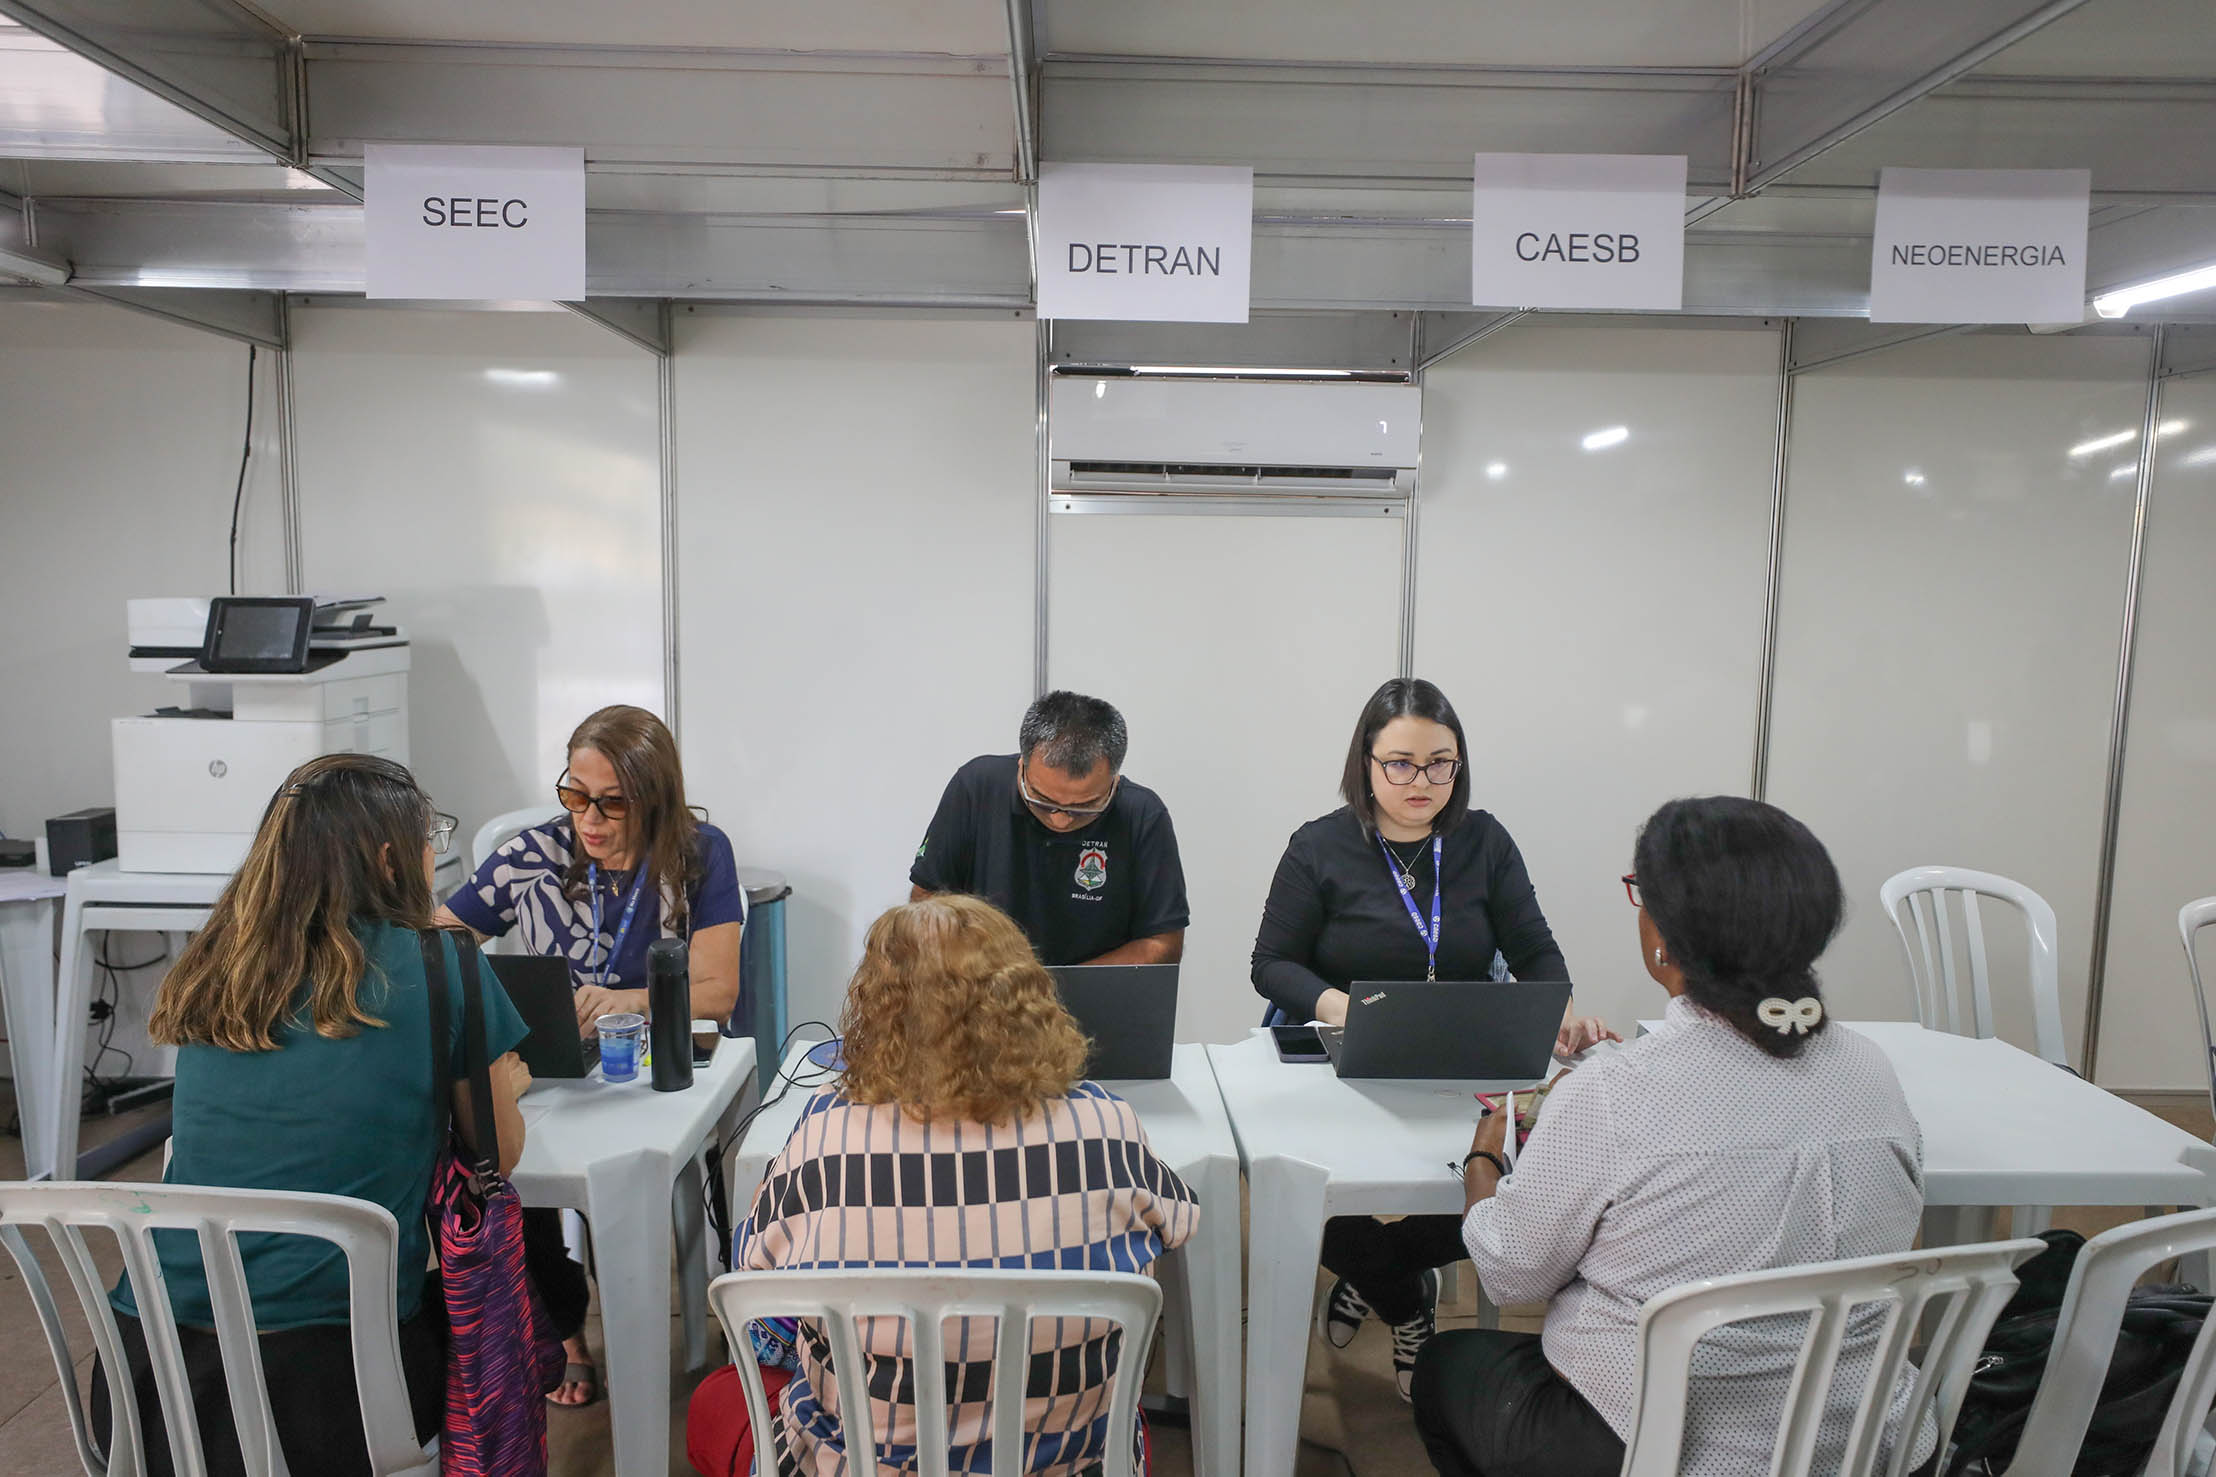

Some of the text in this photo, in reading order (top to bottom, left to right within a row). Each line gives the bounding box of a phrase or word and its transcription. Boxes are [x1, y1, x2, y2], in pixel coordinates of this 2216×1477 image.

[422, 196, 528, 229] SEEC
[1068, 243, 1220, 276] DETRAN
[1515, 232, 1640, 264] CAESB
[1892, 243, 2067, 268] NEOENERGIA
[1081, 840, 1109, 848] DETRAN
